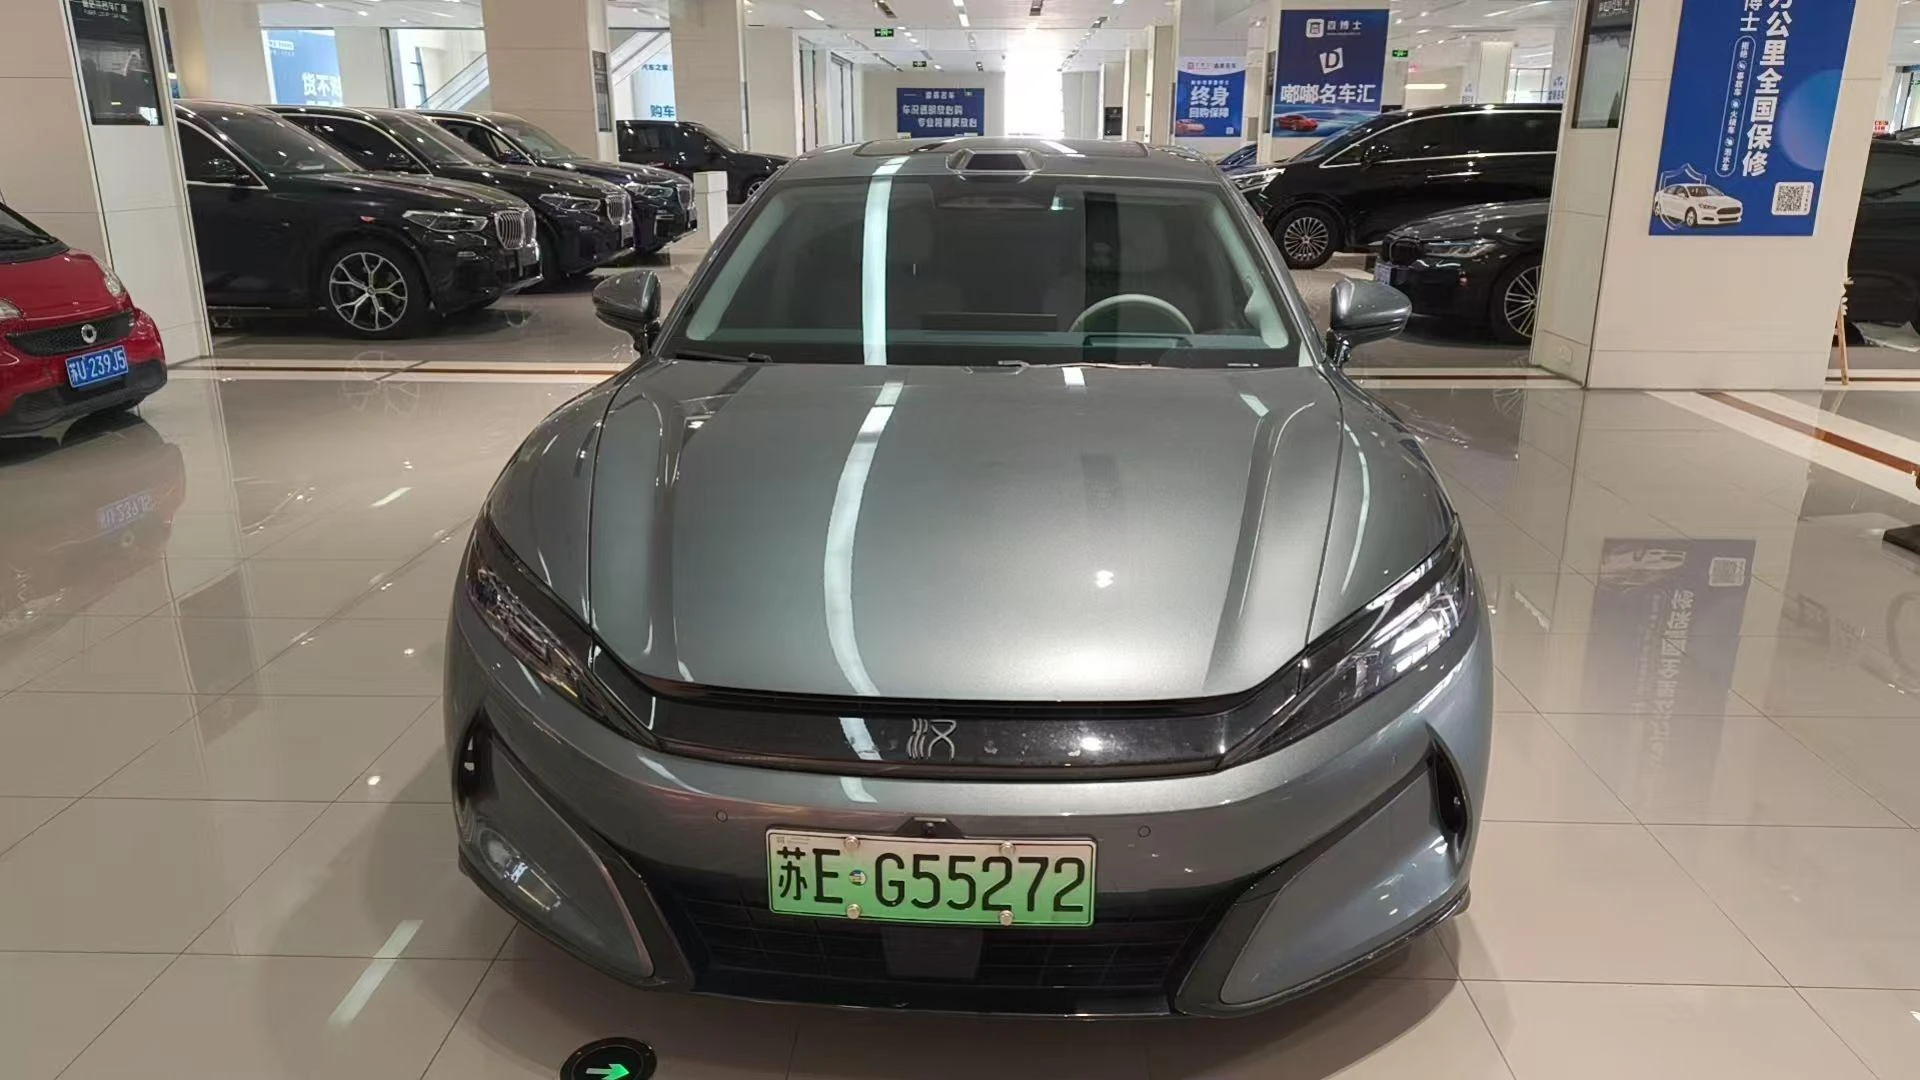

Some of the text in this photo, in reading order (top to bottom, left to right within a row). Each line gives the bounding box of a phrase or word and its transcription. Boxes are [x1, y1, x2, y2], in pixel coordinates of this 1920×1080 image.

[1190, 85, 1230, 106] 终身
[1280, 84, 1376, 104] 嘟嘟名车汇
[650, 104, 676, 118] 购车
